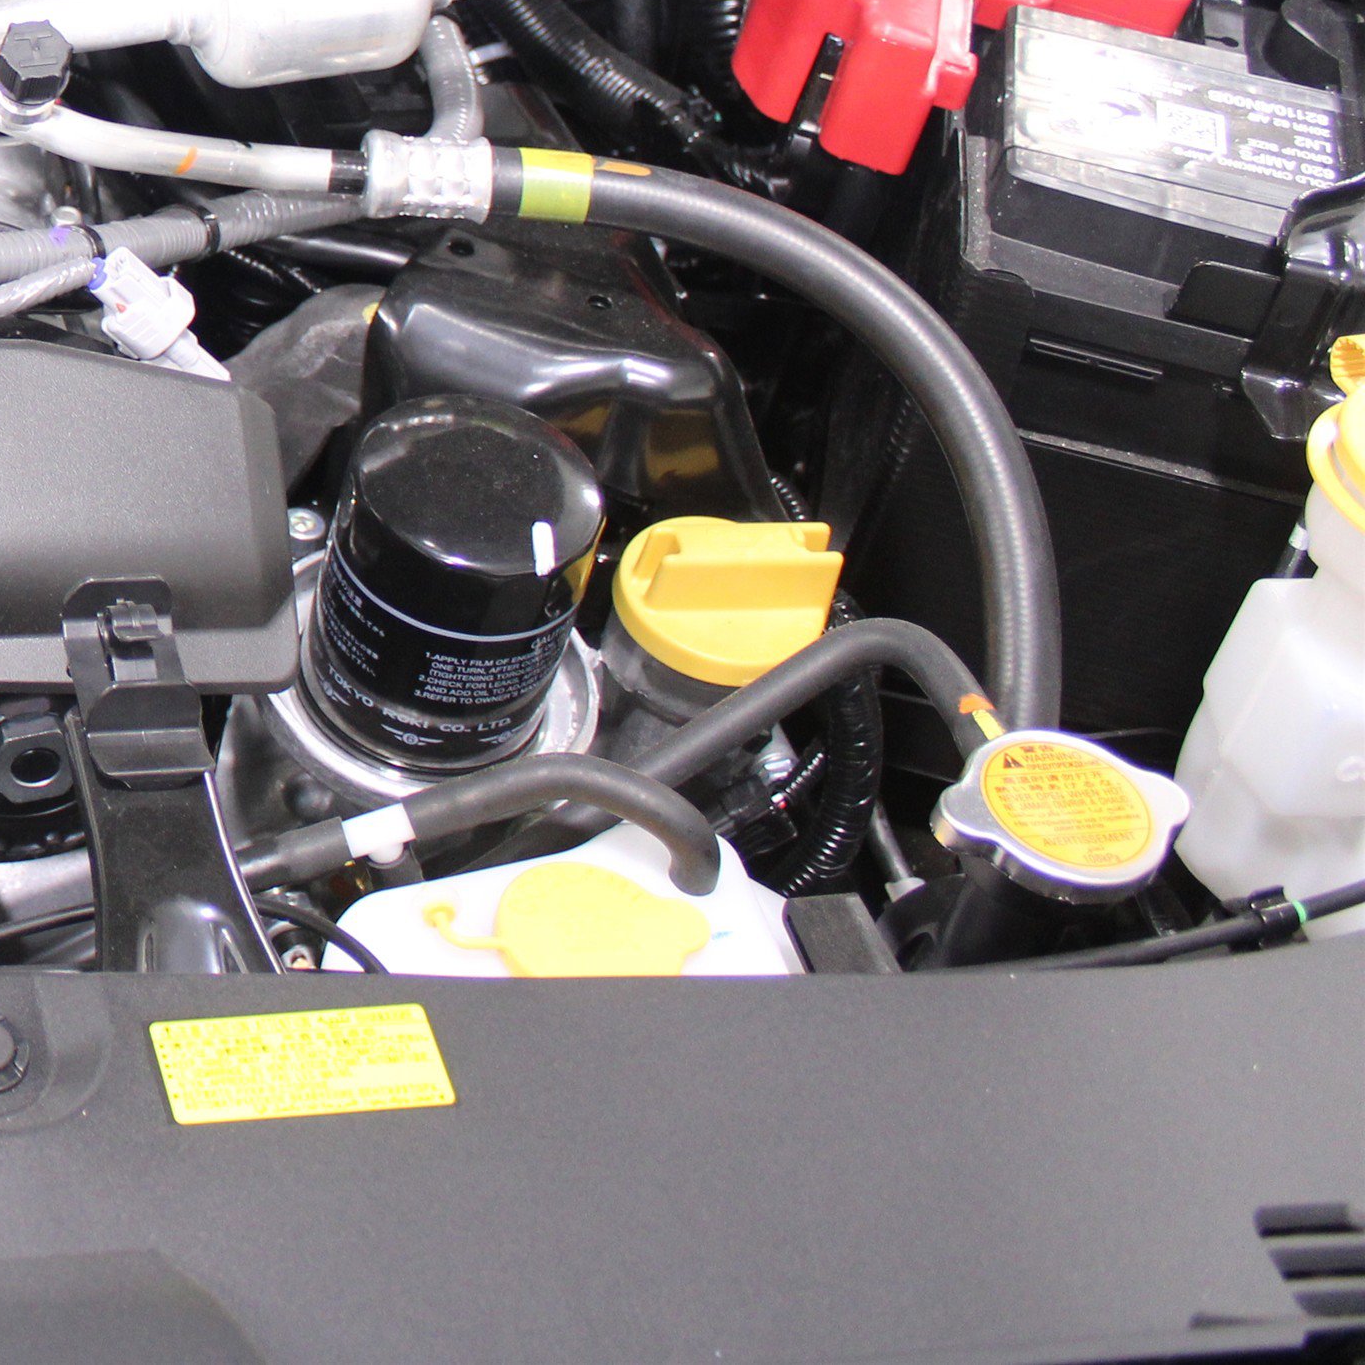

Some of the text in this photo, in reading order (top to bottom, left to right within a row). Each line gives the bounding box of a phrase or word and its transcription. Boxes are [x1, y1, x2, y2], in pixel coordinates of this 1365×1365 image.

[1294, 135, 1332, 153] LN2
[1280, 146, 1334, 165] GROUP
[1217, 156, 1294, 181] CRANKING
[1238, 148, 1336, 180] 620 AMPS
[431, 661, 454, 672] ONE
[469, 659, 494, 667] FILM
[328, 663, 374, 708] TOKYO
[424, 684, 448, 695] AND
[449, 688, 471, 697] ADD
[465, 682, 487, 690] FOR
[459, 696, 473, 705] TO
[1021, 751, 1082, 763] WARNING
[1068, 788, 1099, 798] WHEN
[1042, 831, 1135, 847] AVERTISSEMENT
